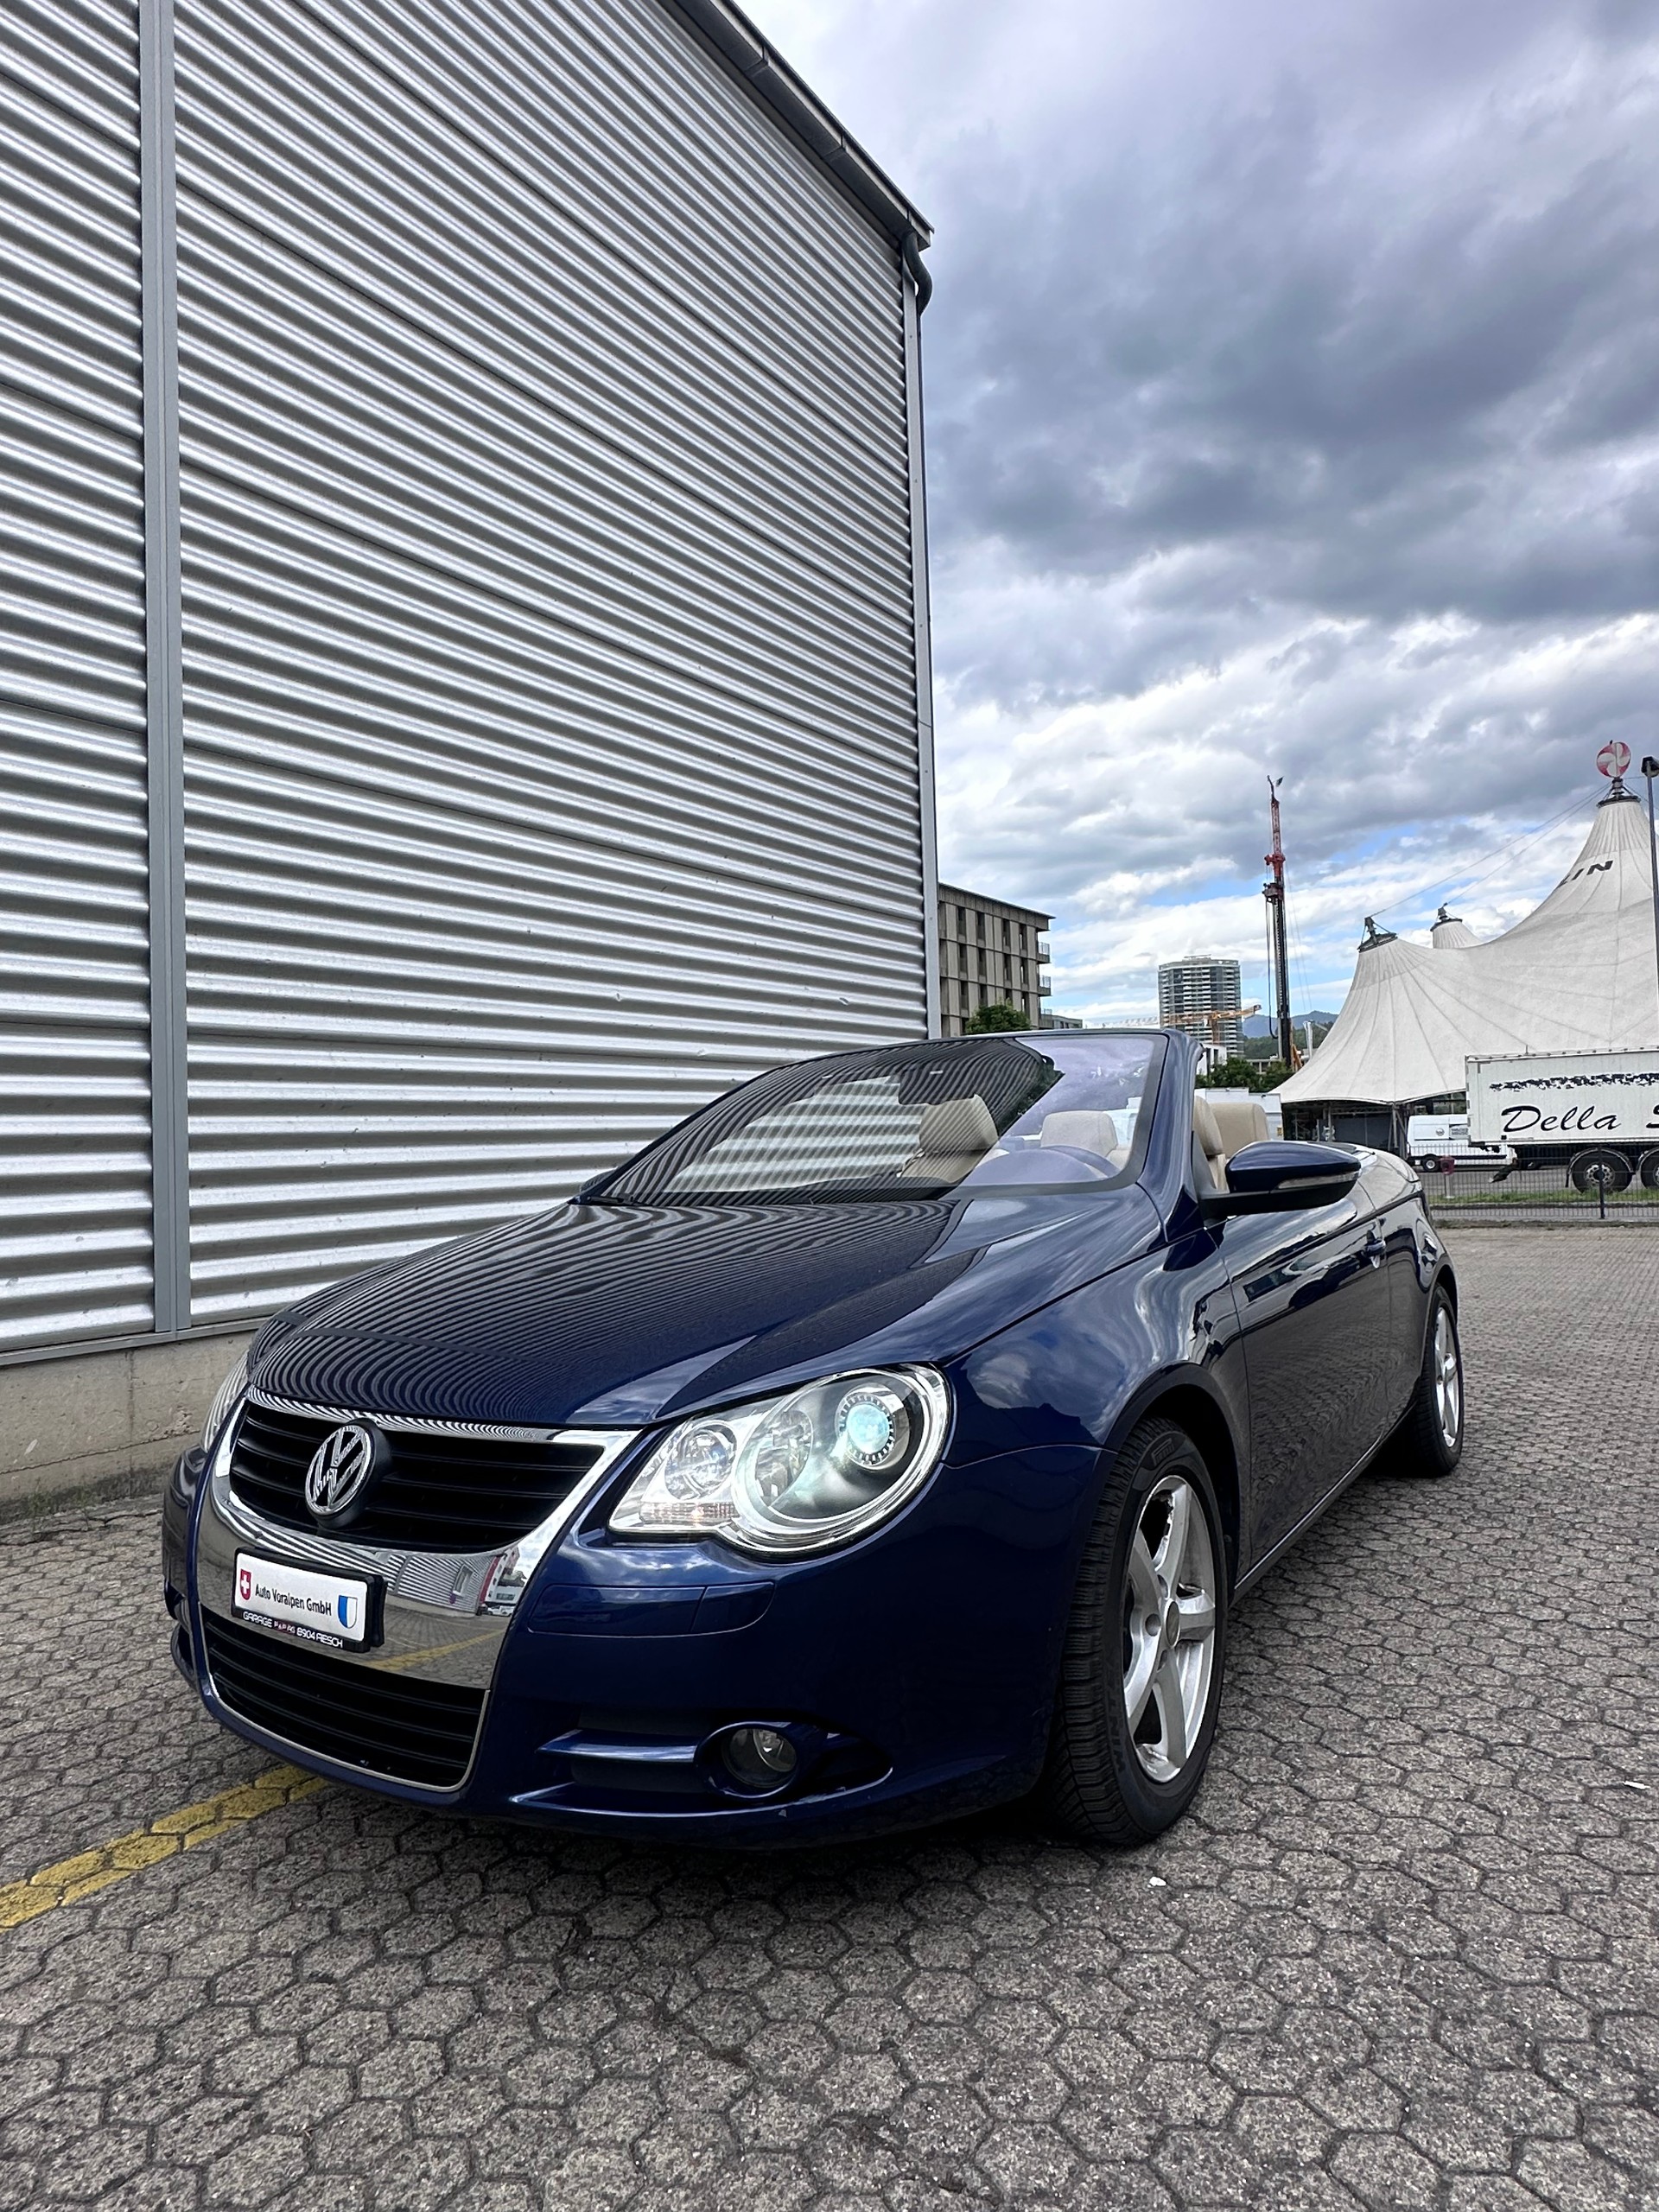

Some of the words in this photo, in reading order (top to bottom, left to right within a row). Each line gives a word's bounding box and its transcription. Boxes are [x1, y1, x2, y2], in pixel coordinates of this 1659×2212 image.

[1501, 1104, 1622, 1133] Della
[255, 1583, 271, 1600] Auto
[272, 1588, 305, 1610] Voralpen
[306, 1598, 332, 1616] GmbH
[243, 1611, 273, 1628] GARAGE
[296, 1627, 316, 1641] 8904
